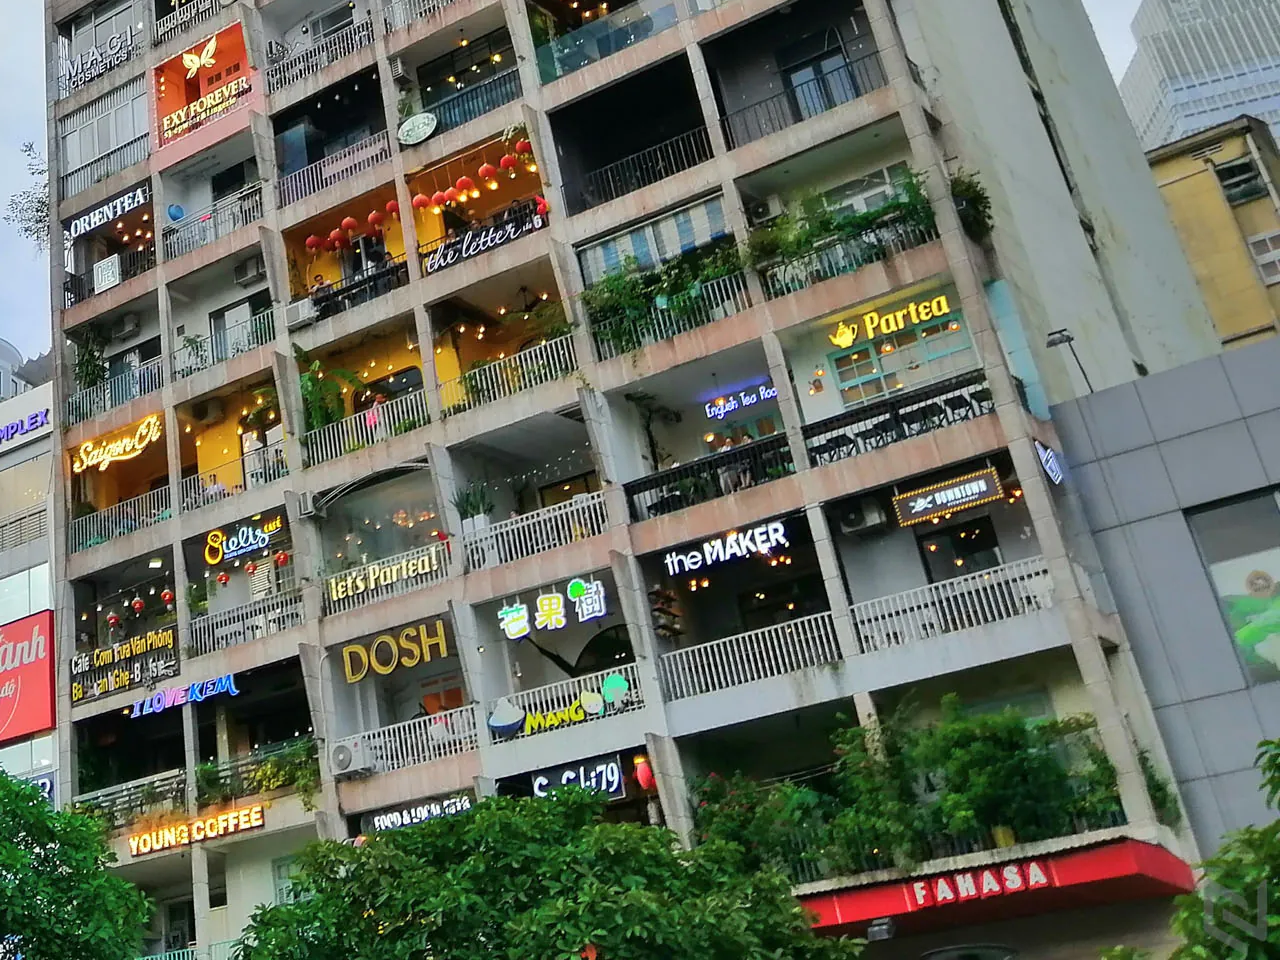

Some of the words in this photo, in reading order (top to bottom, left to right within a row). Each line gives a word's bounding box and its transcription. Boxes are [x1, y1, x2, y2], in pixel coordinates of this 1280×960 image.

[71, 49, 128, 88] COSMETICS
[189, 76, 249, 118] FOREVER
[71, 187, 145, 237] ORIENTEA
[425, 243, 459, 273] the
[461, 222, 522, 258] letter
[532, 214, 543, 229] 6
[863, 295, 951, 339] Partea
[739, 391, 758, 407] Tea
[758, 385, 778, 400] Roo
[934, 479, 988, 506] DOWNTOWN
[664, 551, 702, 576] the
[703, 521, 787, 566] MAKER
[343, 619, 448, 683] DOSH
[131, 701, 141, 718] I
[143, 686, 188, 715] LOVE
[188, 674, 240, 702] KEM
[129, 824, 189, 856] YOUNG
[192, 804, 263, 841] COFFEE
[374, 811, 402, 831] FOOD
[402, 809, 412, 825] &
[913, 861, 1047, 905] FAHASA
